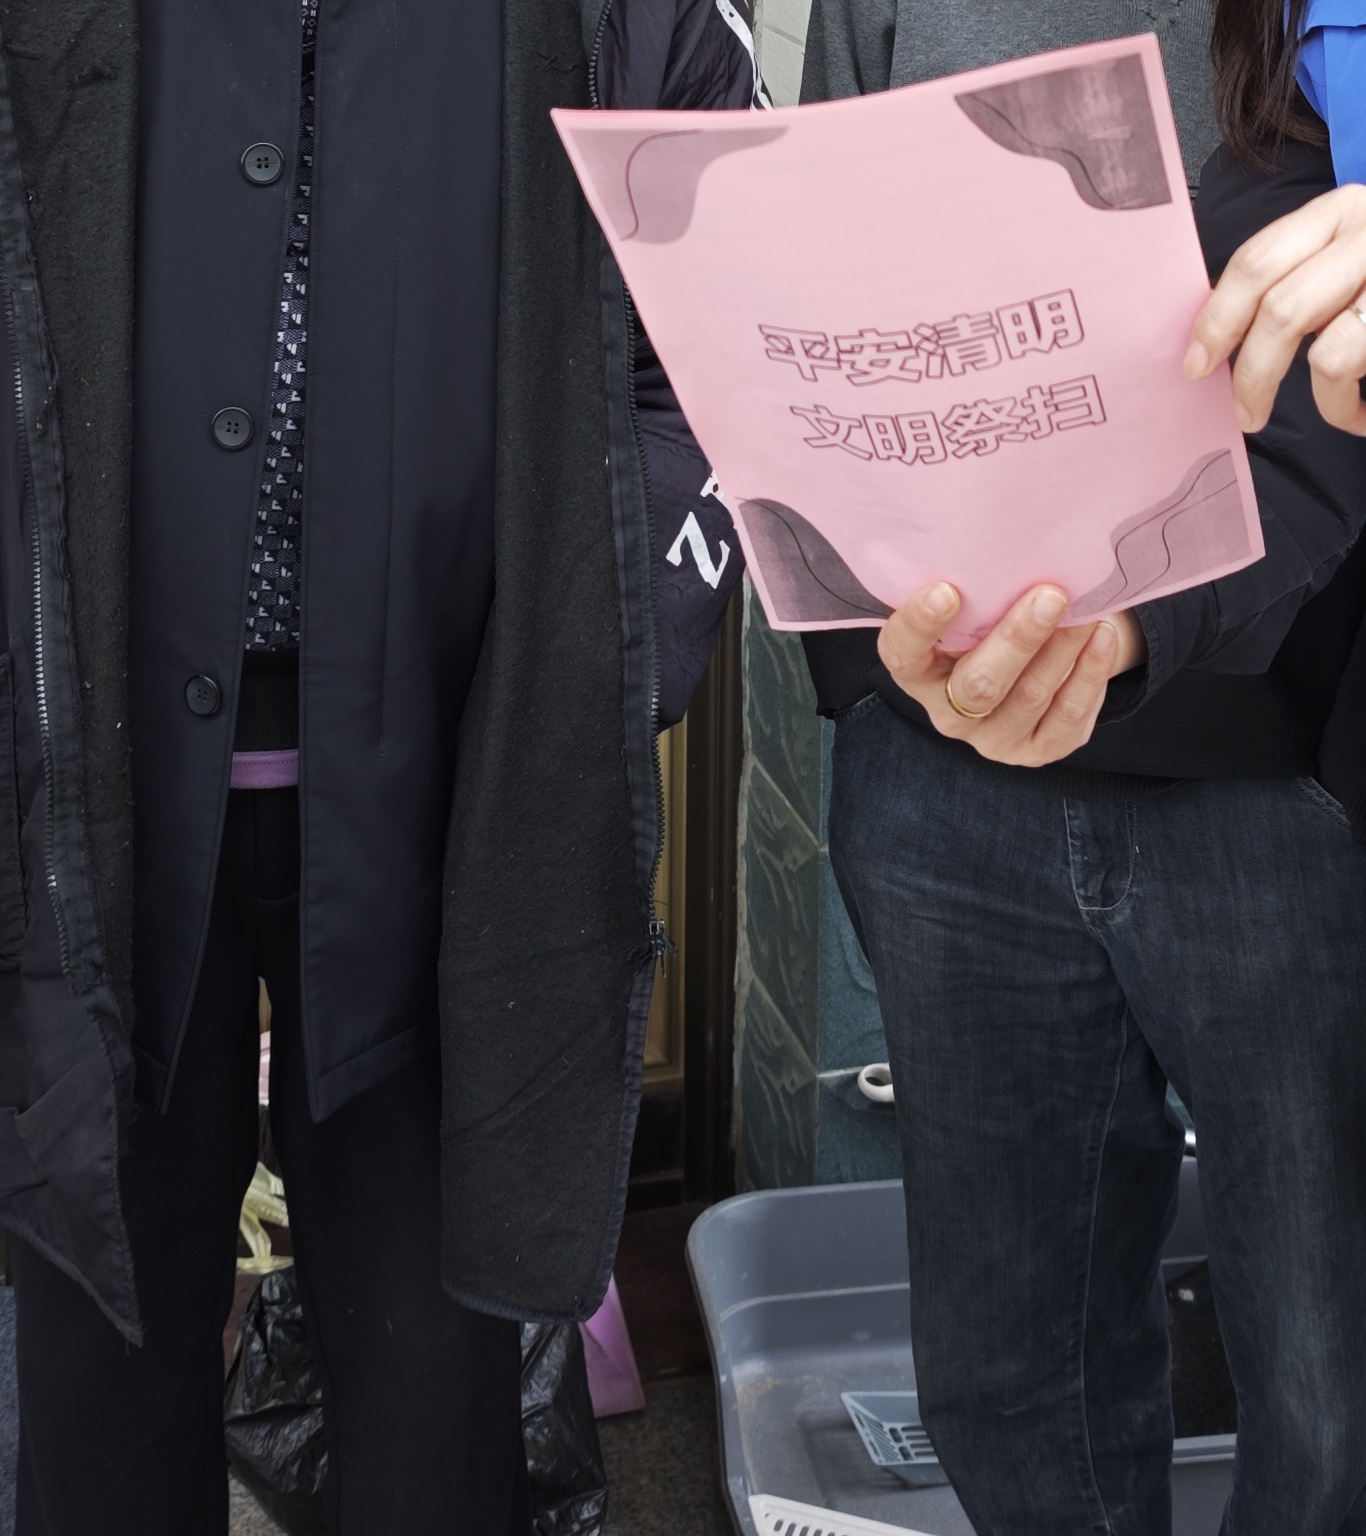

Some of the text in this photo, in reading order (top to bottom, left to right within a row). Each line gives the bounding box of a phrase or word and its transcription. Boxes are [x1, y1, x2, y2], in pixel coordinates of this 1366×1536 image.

[758, 288, 1085, 387] 平安清明
[789, 374, 1107, 467] 文明祭扫
